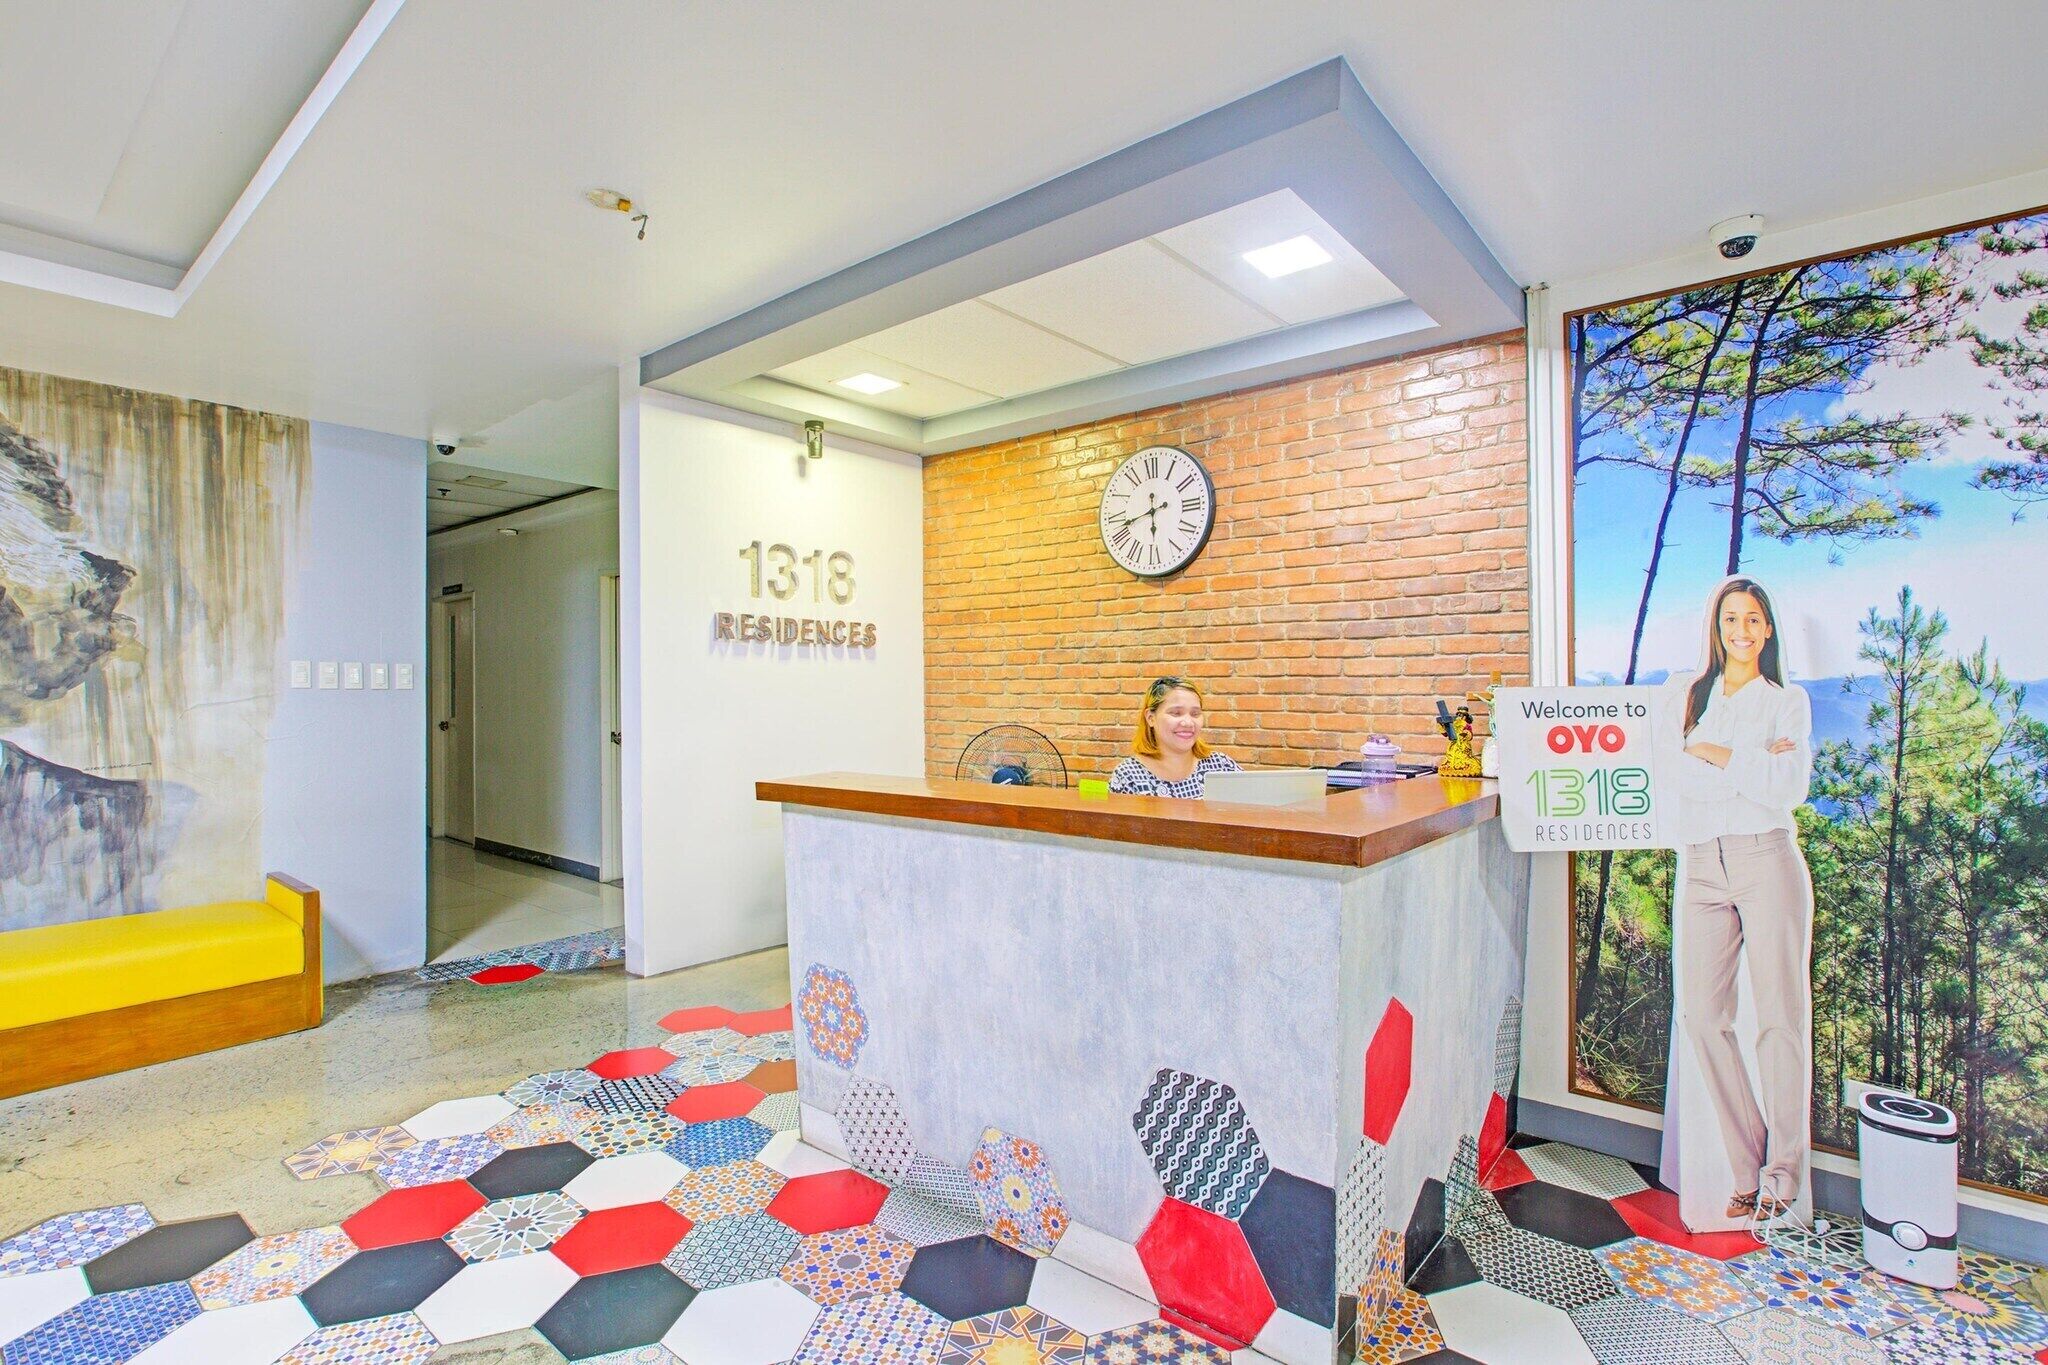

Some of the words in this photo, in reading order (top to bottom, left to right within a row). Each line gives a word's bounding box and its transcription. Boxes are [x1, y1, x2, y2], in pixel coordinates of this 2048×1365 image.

[1176, 473, 1195, 493] II
[1181, 496, 1201, 513] III
[739, 540, 857, 605] 1318
[714, 612, 877, 649] RESIDENCES
[1521, 700, 1618, 719] Welcome
[1624, 702, 1647, 717] to
[1547, 724, 1626, 754] OYO
[1526, 768, 1651, 817] 1318
[1535, 822, 1652, 842] RESIDENCES
